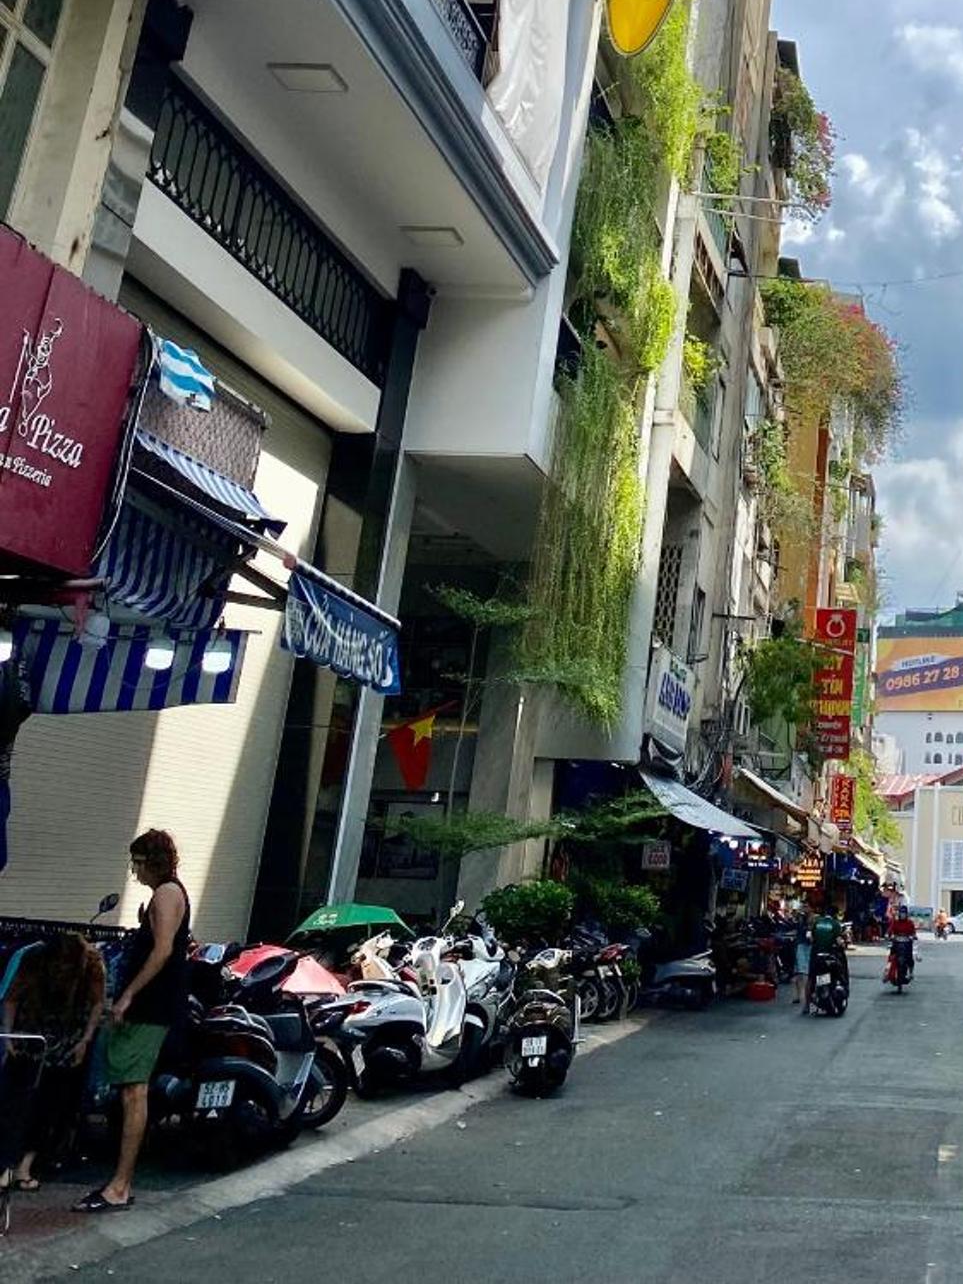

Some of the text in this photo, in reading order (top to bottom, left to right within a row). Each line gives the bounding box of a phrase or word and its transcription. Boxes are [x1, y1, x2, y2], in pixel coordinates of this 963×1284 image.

[27, 413, 84, 468] Pizza
[885, 672, 921, 691] 0986
[923, 669, 940, 684] 27
[942, 666, 960, 680] 28
